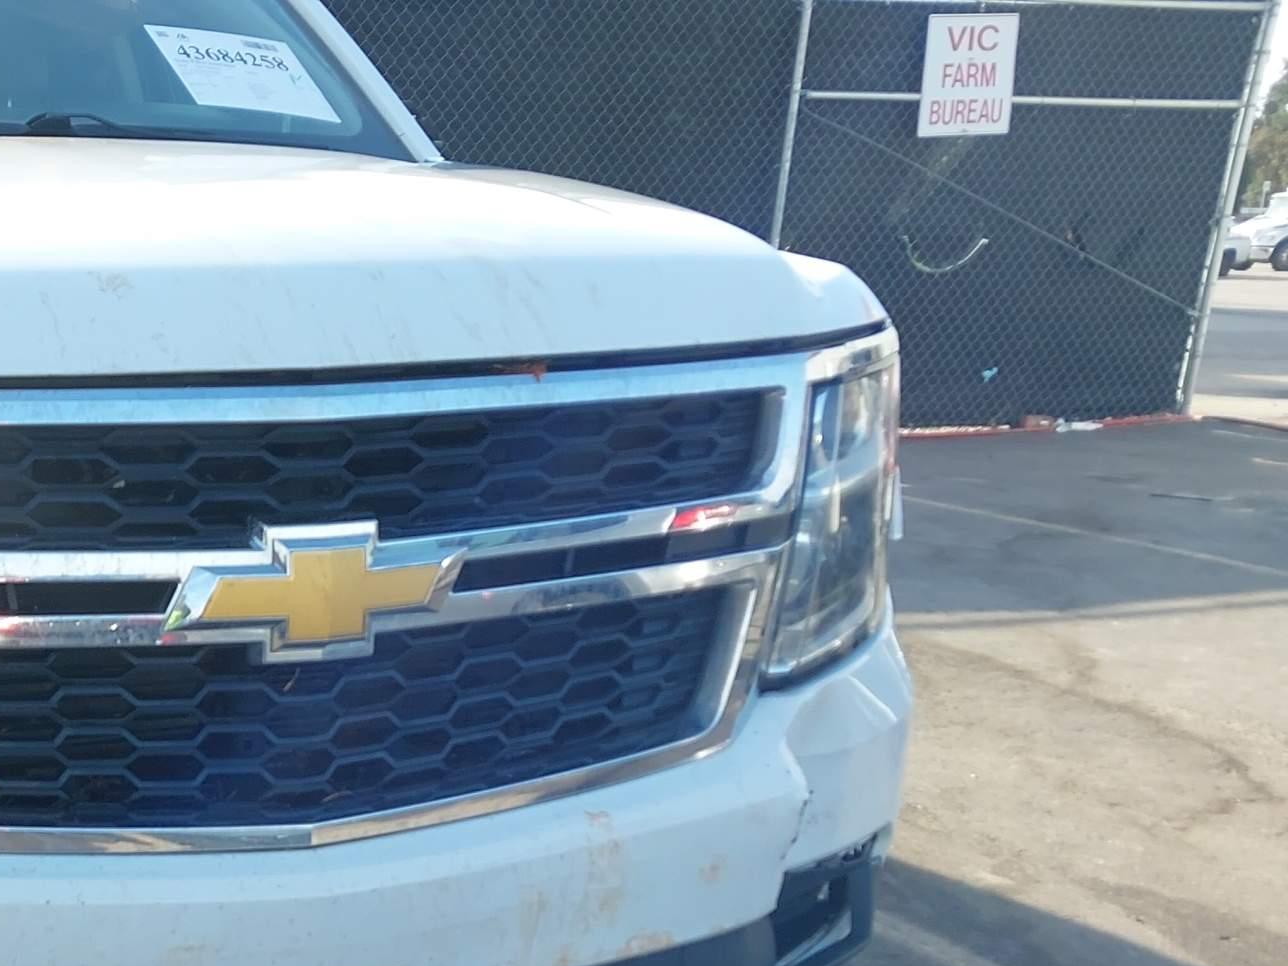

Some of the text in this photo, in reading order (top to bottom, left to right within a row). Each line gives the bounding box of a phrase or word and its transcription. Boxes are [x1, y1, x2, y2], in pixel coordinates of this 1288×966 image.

[948, 25, 1000, 52] VIC
[177, 44, 289, 71] 43684258
[942, 62, 997, 88] FARM
[929, 98, 1004, 125] BUREAU
